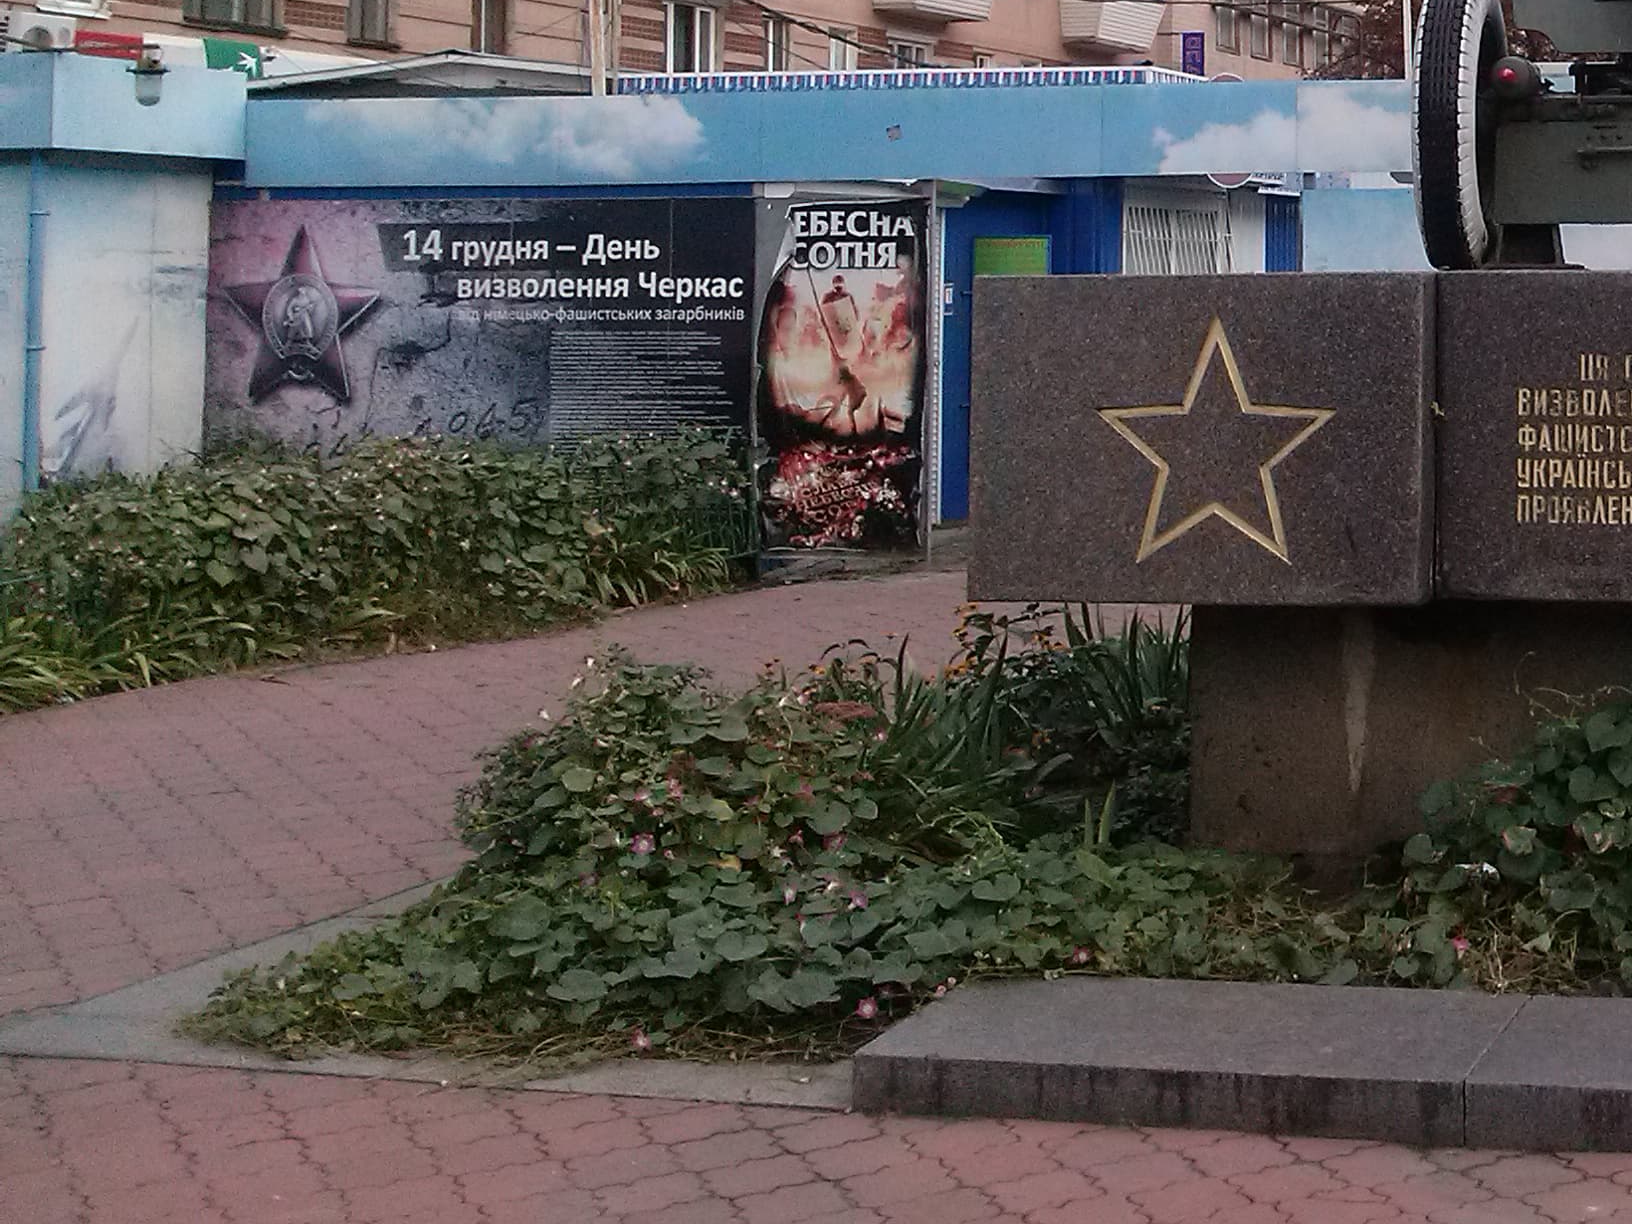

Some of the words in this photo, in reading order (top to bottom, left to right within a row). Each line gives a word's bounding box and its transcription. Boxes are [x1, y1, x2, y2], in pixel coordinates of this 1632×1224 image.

[794, 211, 914, 237] ЕБЕСНА
[403, 229, 443, 262] 14
[451, 239, 549, 267] грудня
[582, 234, 660, 265] День
[793, 241, 897, 269] СОТНЯ
[457, 277, 629, 299] визволення
[638, 272, 744, 304] Черкас
[655, 304, 745, 323] загарбників
[1579, 353, 1609, 381] ЦЯ
